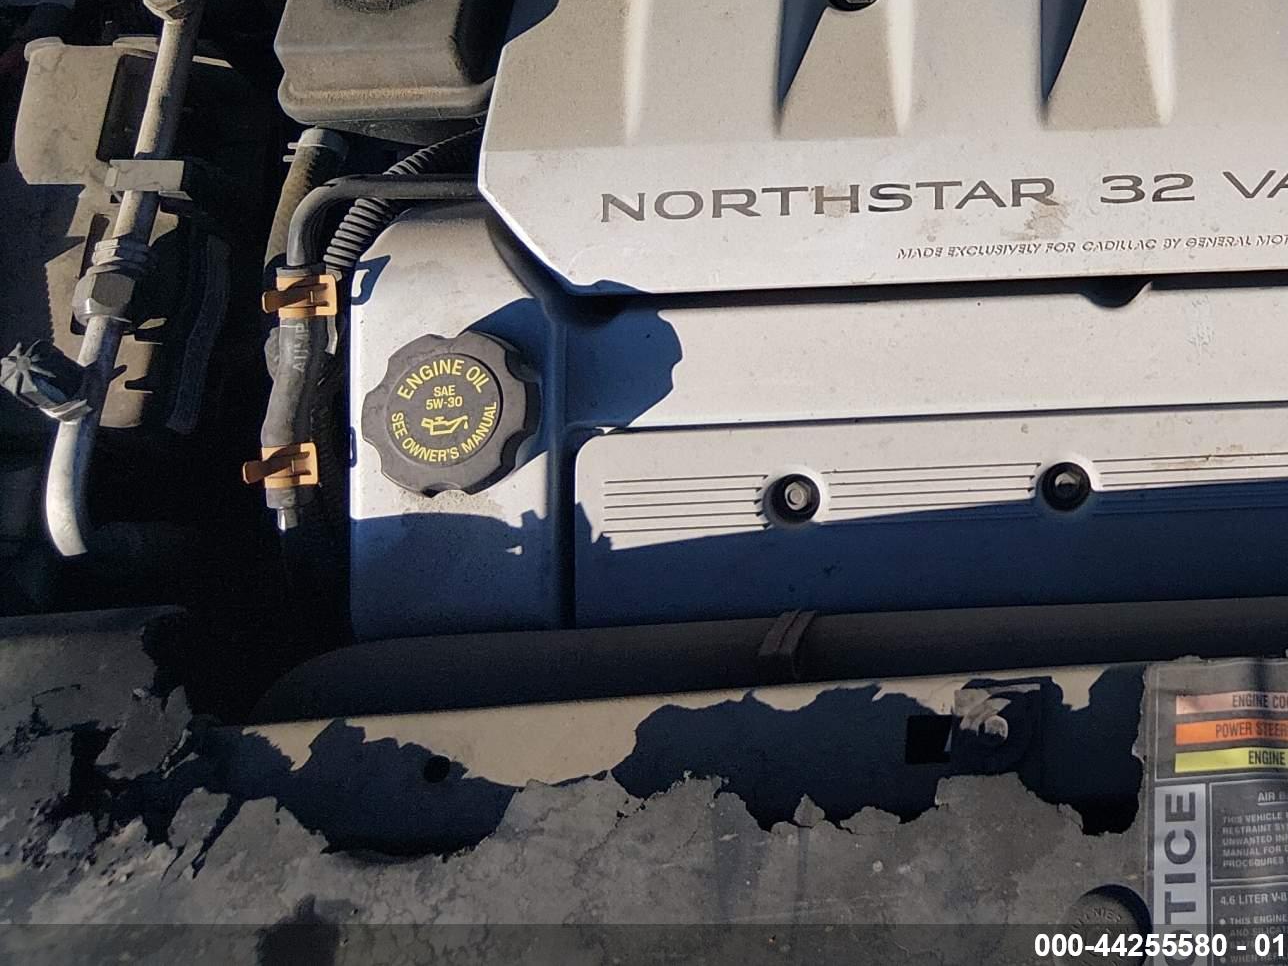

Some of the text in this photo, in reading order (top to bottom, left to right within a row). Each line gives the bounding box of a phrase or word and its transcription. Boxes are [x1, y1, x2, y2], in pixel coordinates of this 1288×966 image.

[600, 176, 1058, 224] NORTHSTAR
[1098, 174, 1197, 203] 32
[897, 246, 943, 260] MADE
[947, 242, 1042, 258] EXCLUSIVELY
[1045, 242, 1076, 254] FOR
[1081, 238, 1158, 253] CADILLAC
[1162, 237, 1182, 250] BY
[1185, 236, 1252, 250] GENERAL
[397, 359, 490, 400] ENGINE OIL
[434, 385, 456, 397] SAE
[426, 396, 463, 410] 5W-30
[391, 401, 497, 462] SEE OWNER'S MANUAL
[1232, 693, 1268, 708] ENGINE
[1216, 721, 1252, 738] POWER
[1248, 750, 1286, 765] ENGINE
[1258, 792, 1275, 802] AIR
[1245, 811, 1282, 822] VEHICLE
[1222, 823, 1272, 834] RESTRAINT
[1222, 847, 1260, 857] MANUAL
[1263, 845, 1282, 855] FOR
[1220, 895, 1236, 906] 4.6
[1238, 893, 1268, 905] LITER
[1230, 917, 1251, 926] THIS
[1253, 914, 1288, 924] ENGINE
